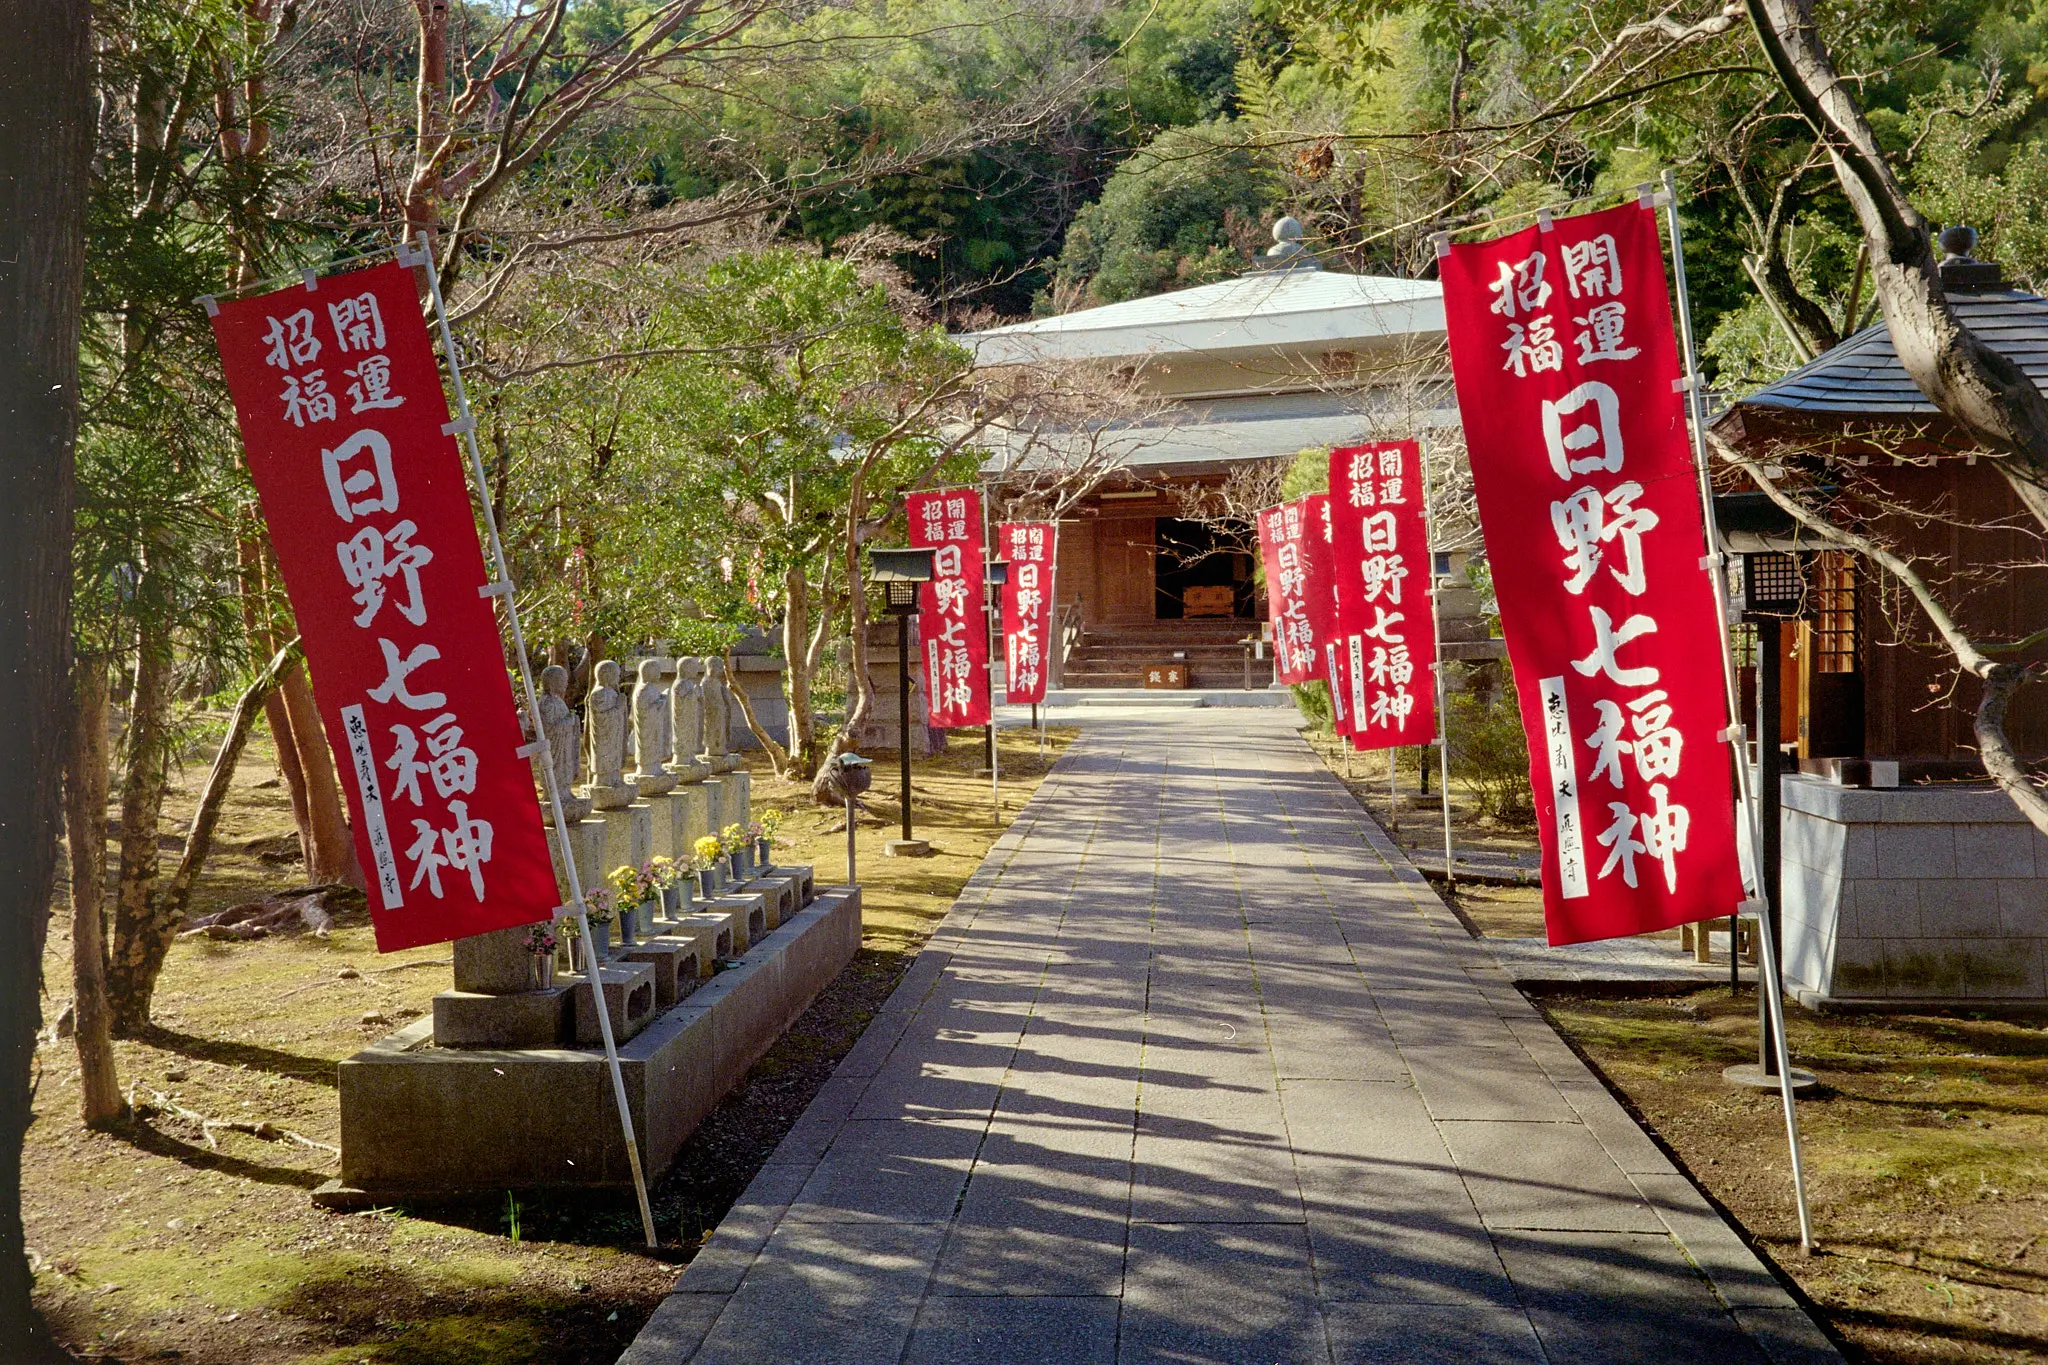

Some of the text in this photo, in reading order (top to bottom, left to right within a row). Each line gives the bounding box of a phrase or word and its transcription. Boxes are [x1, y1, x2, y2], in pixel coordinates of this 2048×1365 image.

[328, 292, 406, 416] 開運
[1489, 251, 1564, 379] 招福
[1561, 234, 1642, 366] 開運
[262, 308, 338, 428] 招福
[921, 500, 944, 542] 招福
[947, 497, 969, 540] 開運
[1267, 511, 1285, 543] 招福
[1284, 506, 1301, 540] 開運
[1348, 452, 1375, 508] 招福
[1379, 449, 1407, 505] 開運
[1011, 528, 1027, 561] 招福
[1029, 528, 1044, 562] 開運
[321, 428, 494, 902] 日野七福神
[934, 544, 972, 717] 日野七福神
[1016, 563, 1043, 696] 日野七福神
[1277, 542, 1316, 672] 日野七福神
[1361, 510, 1415, 732] 日野七福神
[1542, 381, 1690, 894] 日野七福神
